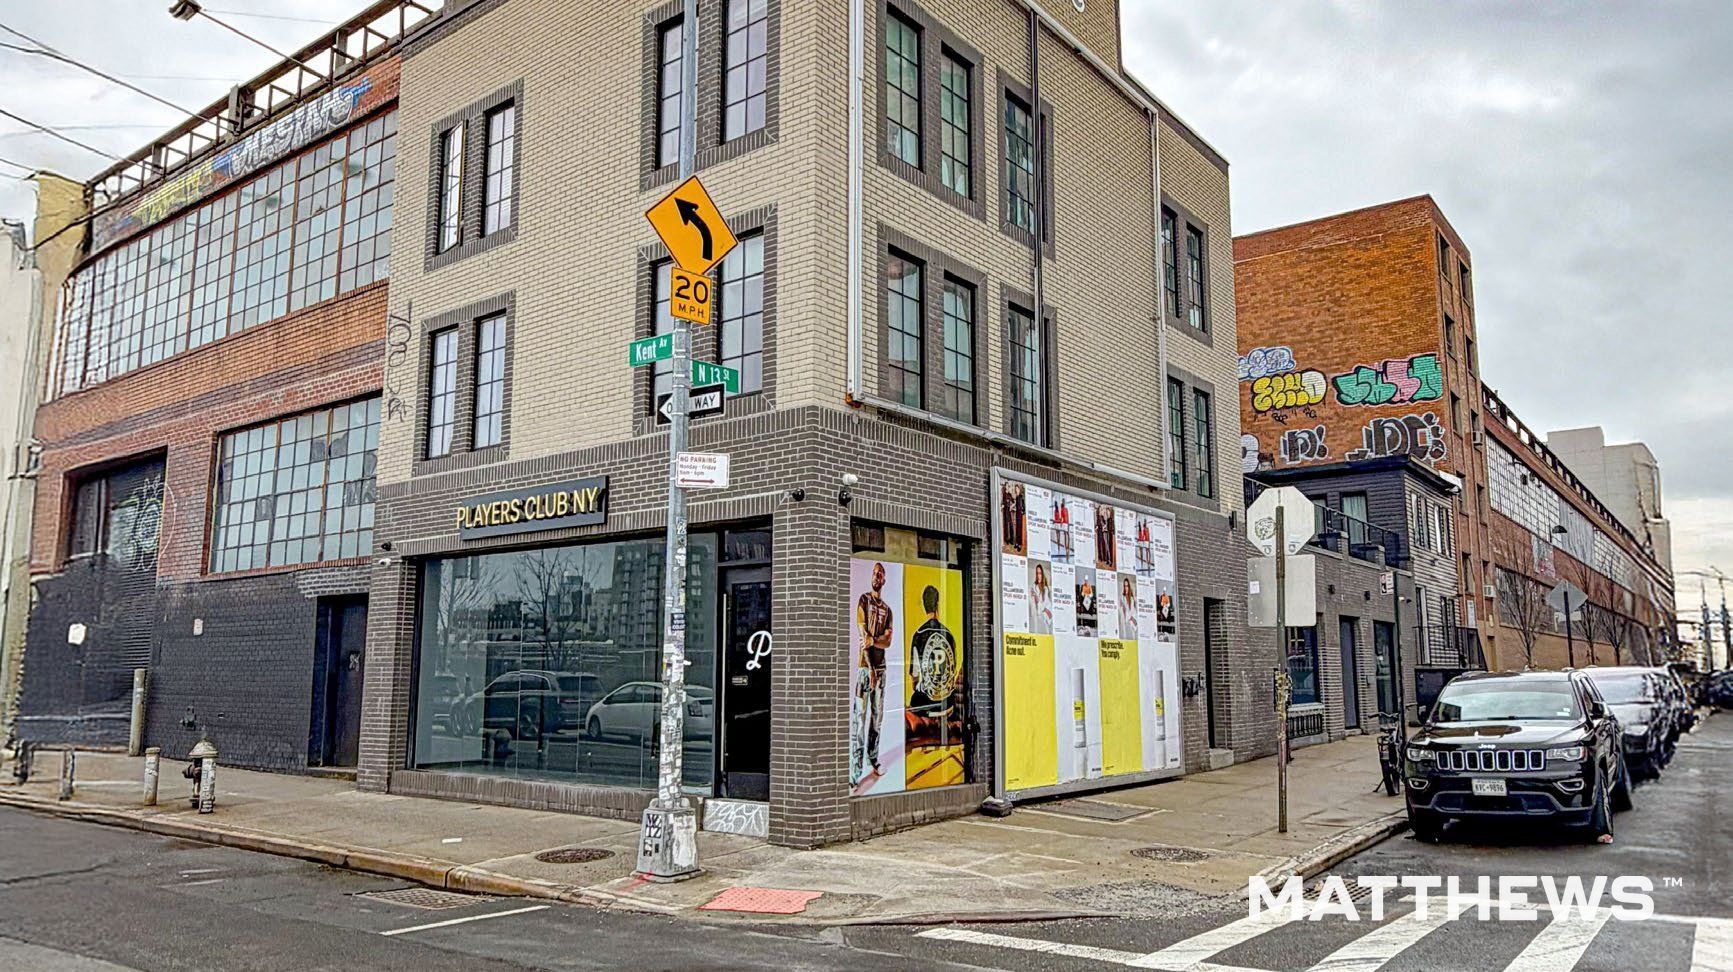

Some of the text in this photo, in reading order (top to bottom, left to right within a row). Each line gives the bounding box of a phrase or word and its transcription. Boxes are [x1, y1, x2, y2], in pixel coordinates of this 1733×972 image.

[675, 275, 708, 304] 20
[635, 342, 657, 362] Kent
[698, 364, 706, 383] N
[710, 366, 720, 384] 13
[694, 394, 716, 410] WAY
[690, 456, 717, 464] PARKING
[456, 486, 598, 529] PLAYERS CLUB NY
[746, 630, 772, 671] P
